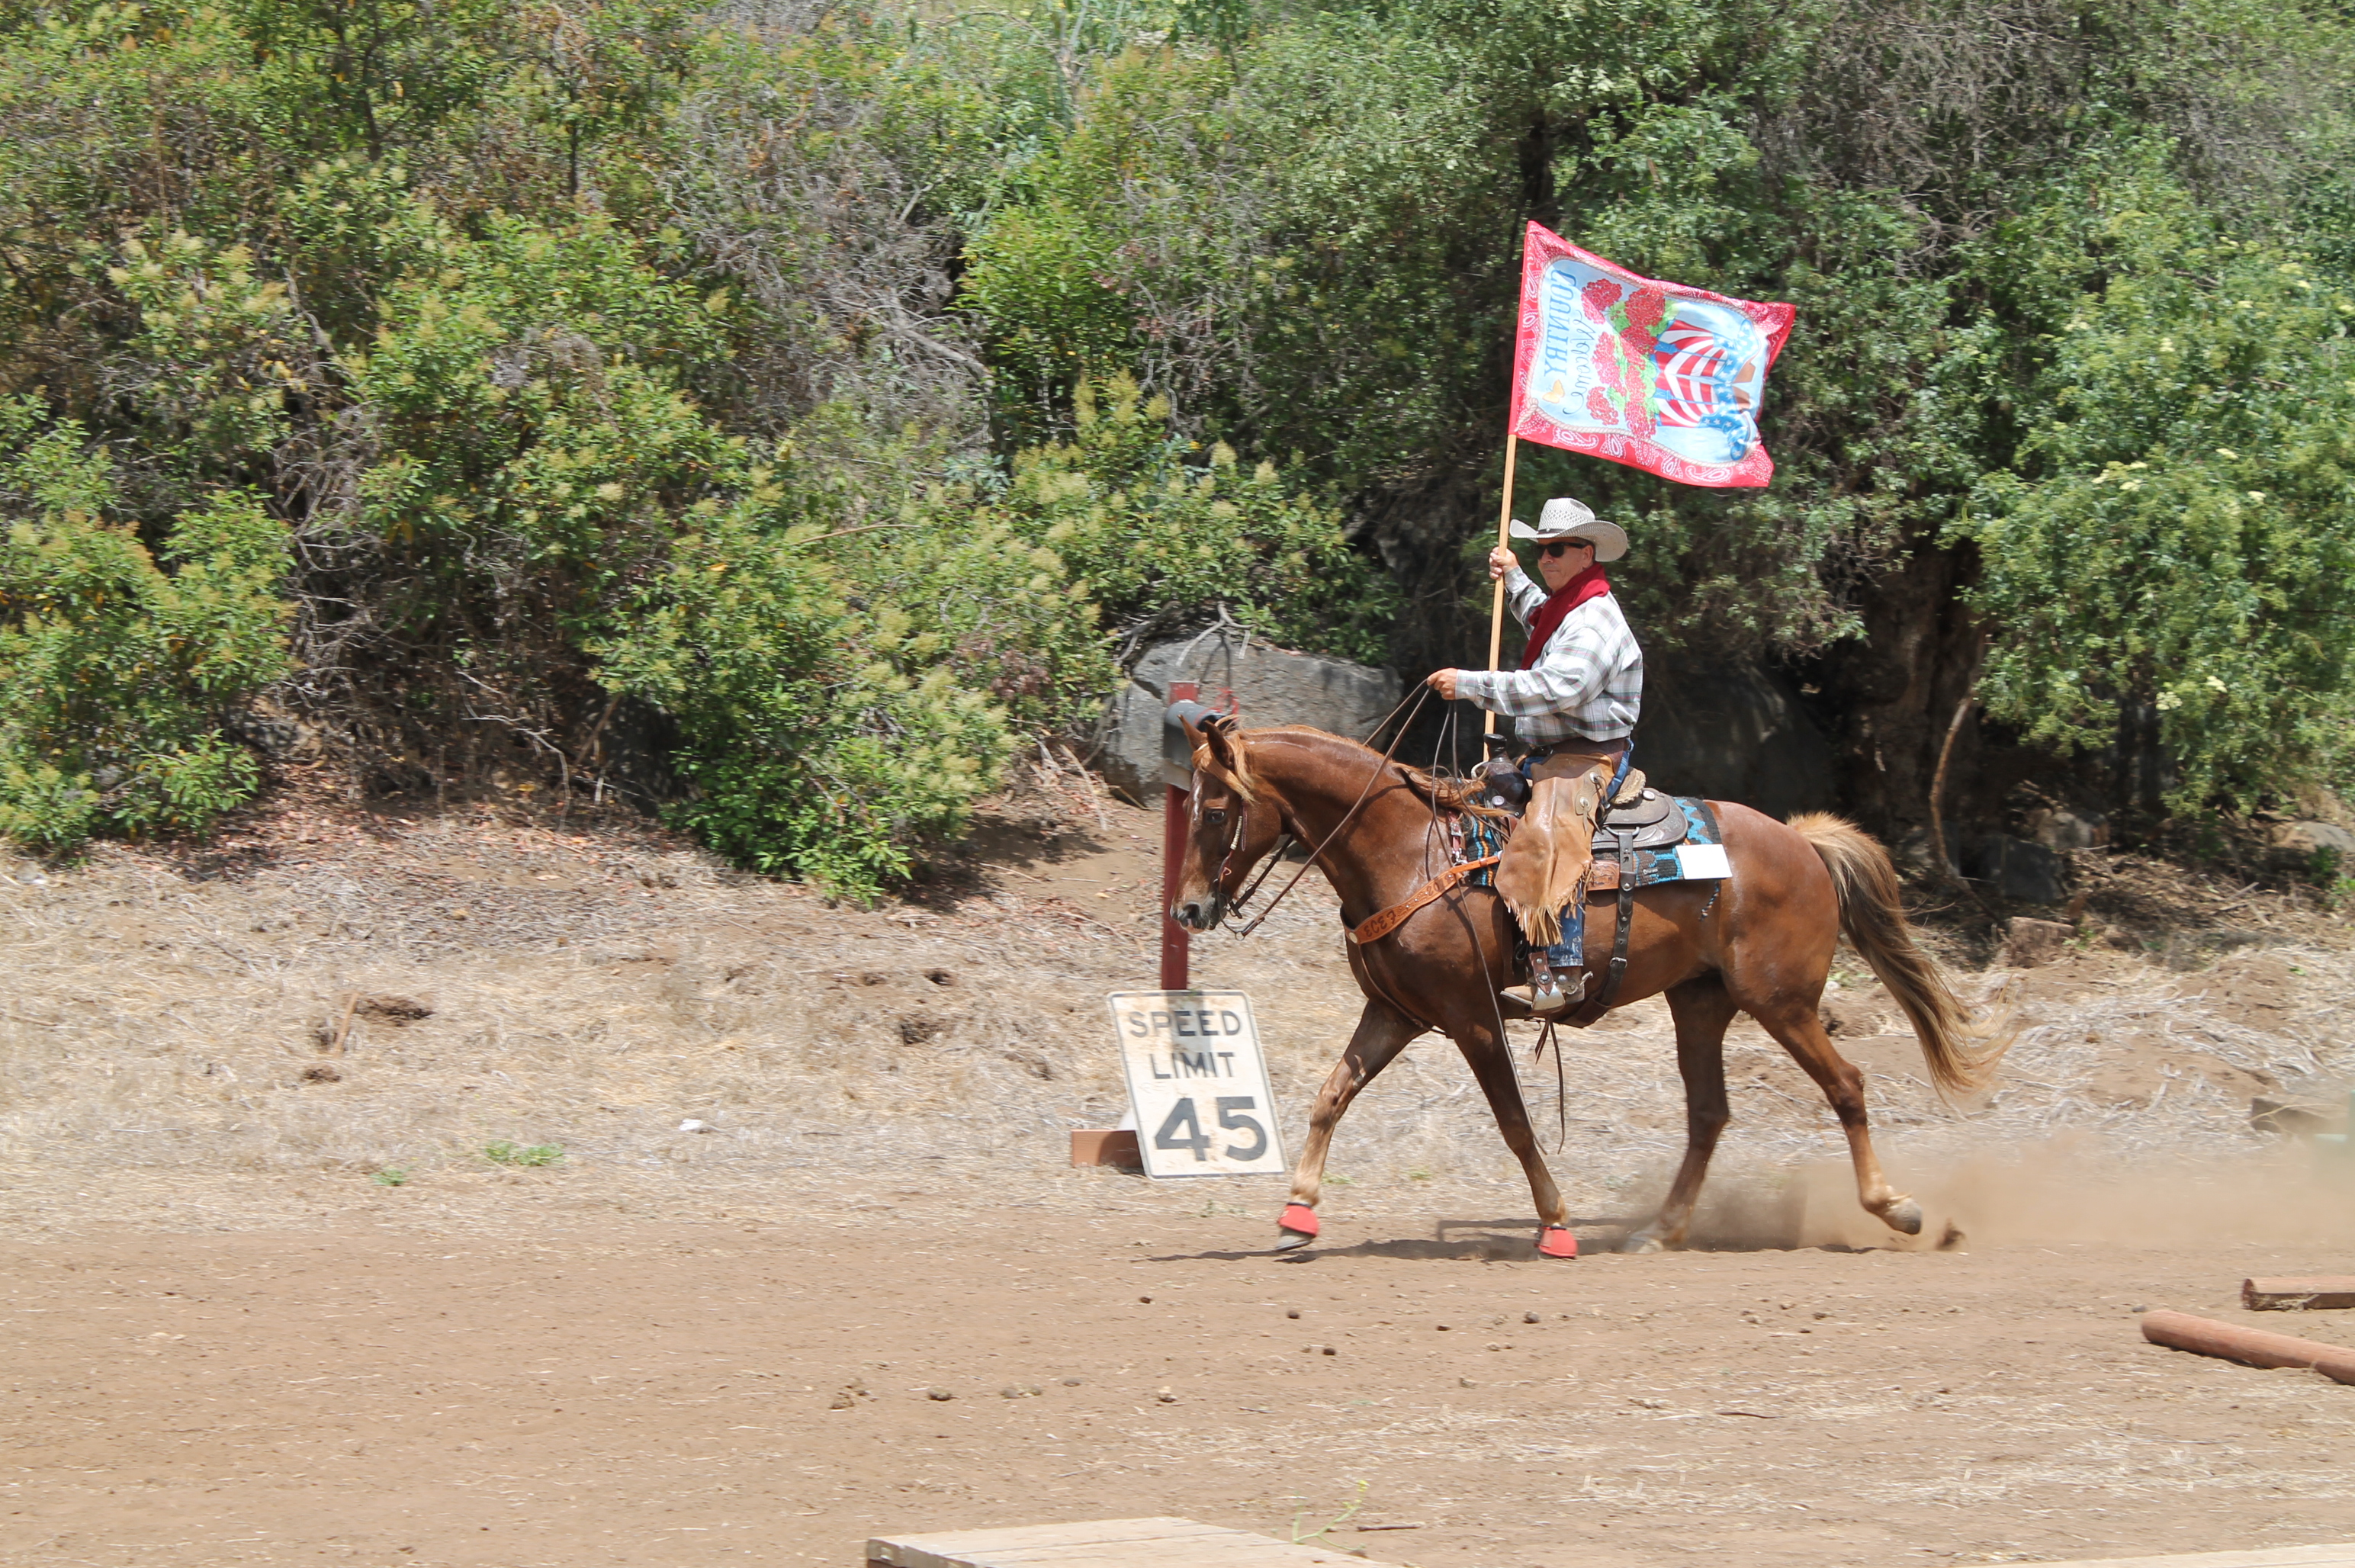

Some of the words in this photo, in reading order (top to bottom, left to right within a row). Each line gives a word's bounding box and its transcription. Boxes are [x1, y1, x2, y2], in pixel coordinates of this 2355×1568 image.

[1129, 1011, 1242, 1037] SPEED
[1149, 1052, 1236, 1079] LIMIT
[1155, 1096, 1267, 1162] 45
